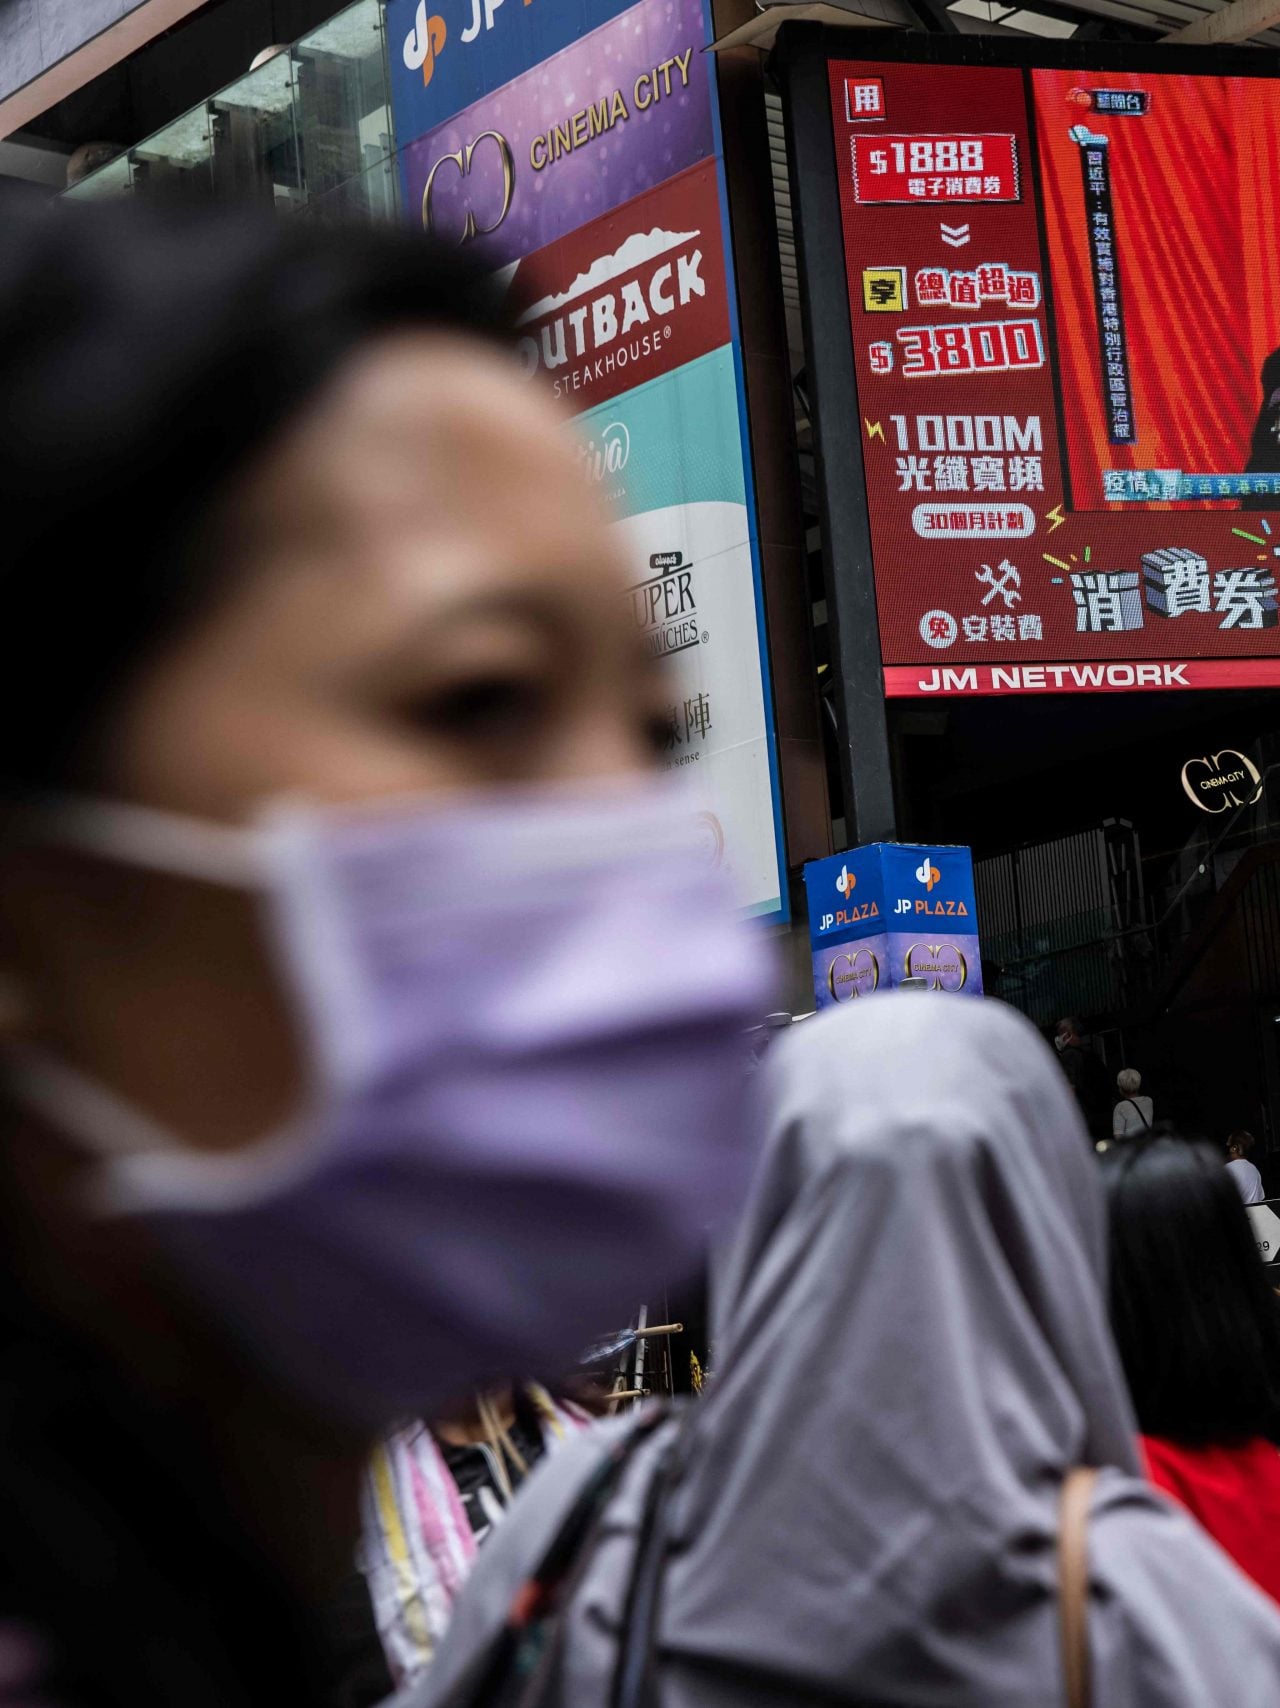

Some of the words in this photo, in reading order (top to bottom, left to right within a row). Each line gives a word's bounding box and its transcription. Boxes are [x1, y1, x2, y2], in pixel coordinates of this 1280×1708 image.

[529, 89, 629, 171] CINEMA
[633, 48, 692, 112] CITY
[854, 85, 880, 112] 用
[869, 141, 984, 174] $1888
[908, 176, 1001, 196] 電子消費券
[869, 279, 897, 304] 享
[916, 263, 1040, 308] 總值超過
[890, 415, 1043, 451] 1000M
[896, 455, 1044, 492] 光纖寬頻
[923, 512, 1025, 531] 30個月計劃
[632, 571, 697, 629] UPER
[928, 616, 950, 639] 免
[962, 614, 1043, 642] 安裝費
[918, 667, 978, 691] JM
[991, 663, 1191, 690] NETWORK
[1200, 775, 1229, 790] CINEMA
[1227, 770, 1245, 783] CITY
[820, 913, 834, 931] JP
[836, 901, 879, 926] PLAZA
[894, 899, 912, 914] JP
[915, 900, 968, 916] PLAZA
